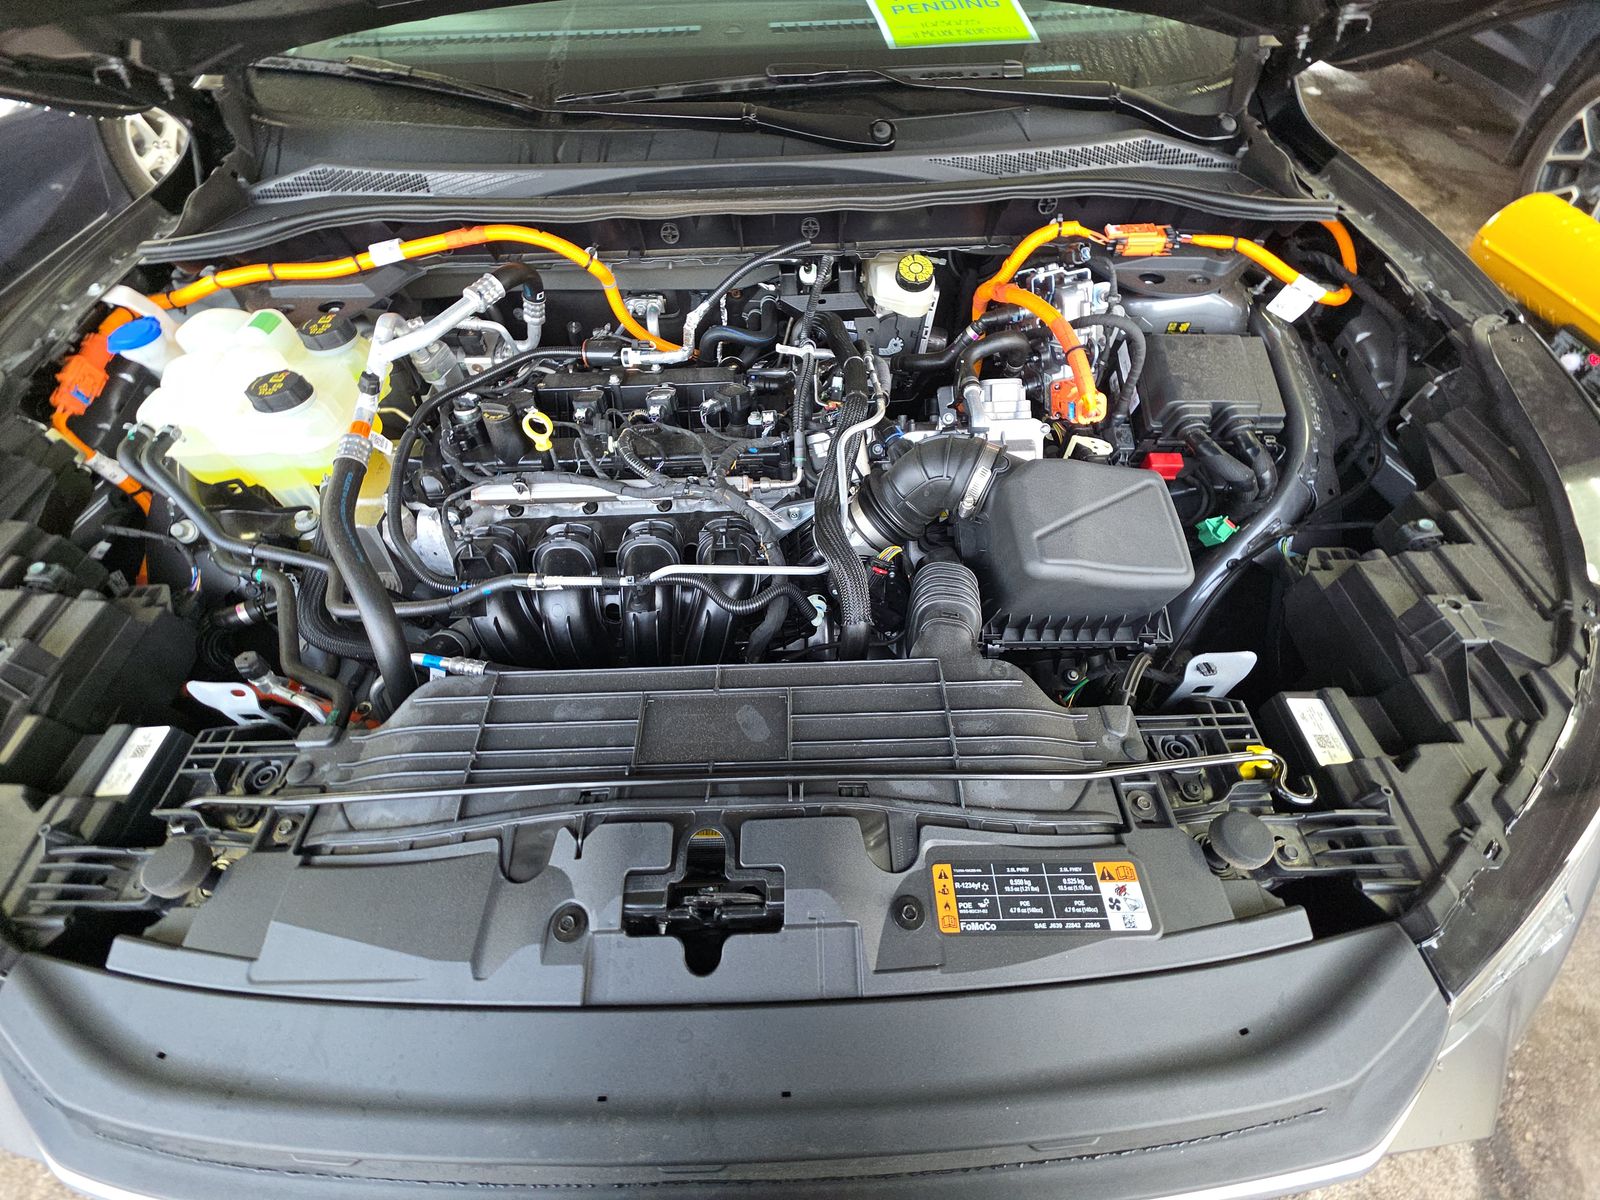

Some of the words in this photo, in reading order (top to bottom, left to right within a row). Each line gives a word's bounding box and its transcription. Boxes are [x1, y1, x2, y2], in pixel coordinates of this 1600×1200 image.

[891, 0, 1000, 15] PENDING
[954, 882, 981, 890] R-1234yf
[1024, 879, 1032, 887] kg
[1077, 878, 1085, 886] kg
[960, 921, 997, 931] FoMoCo
